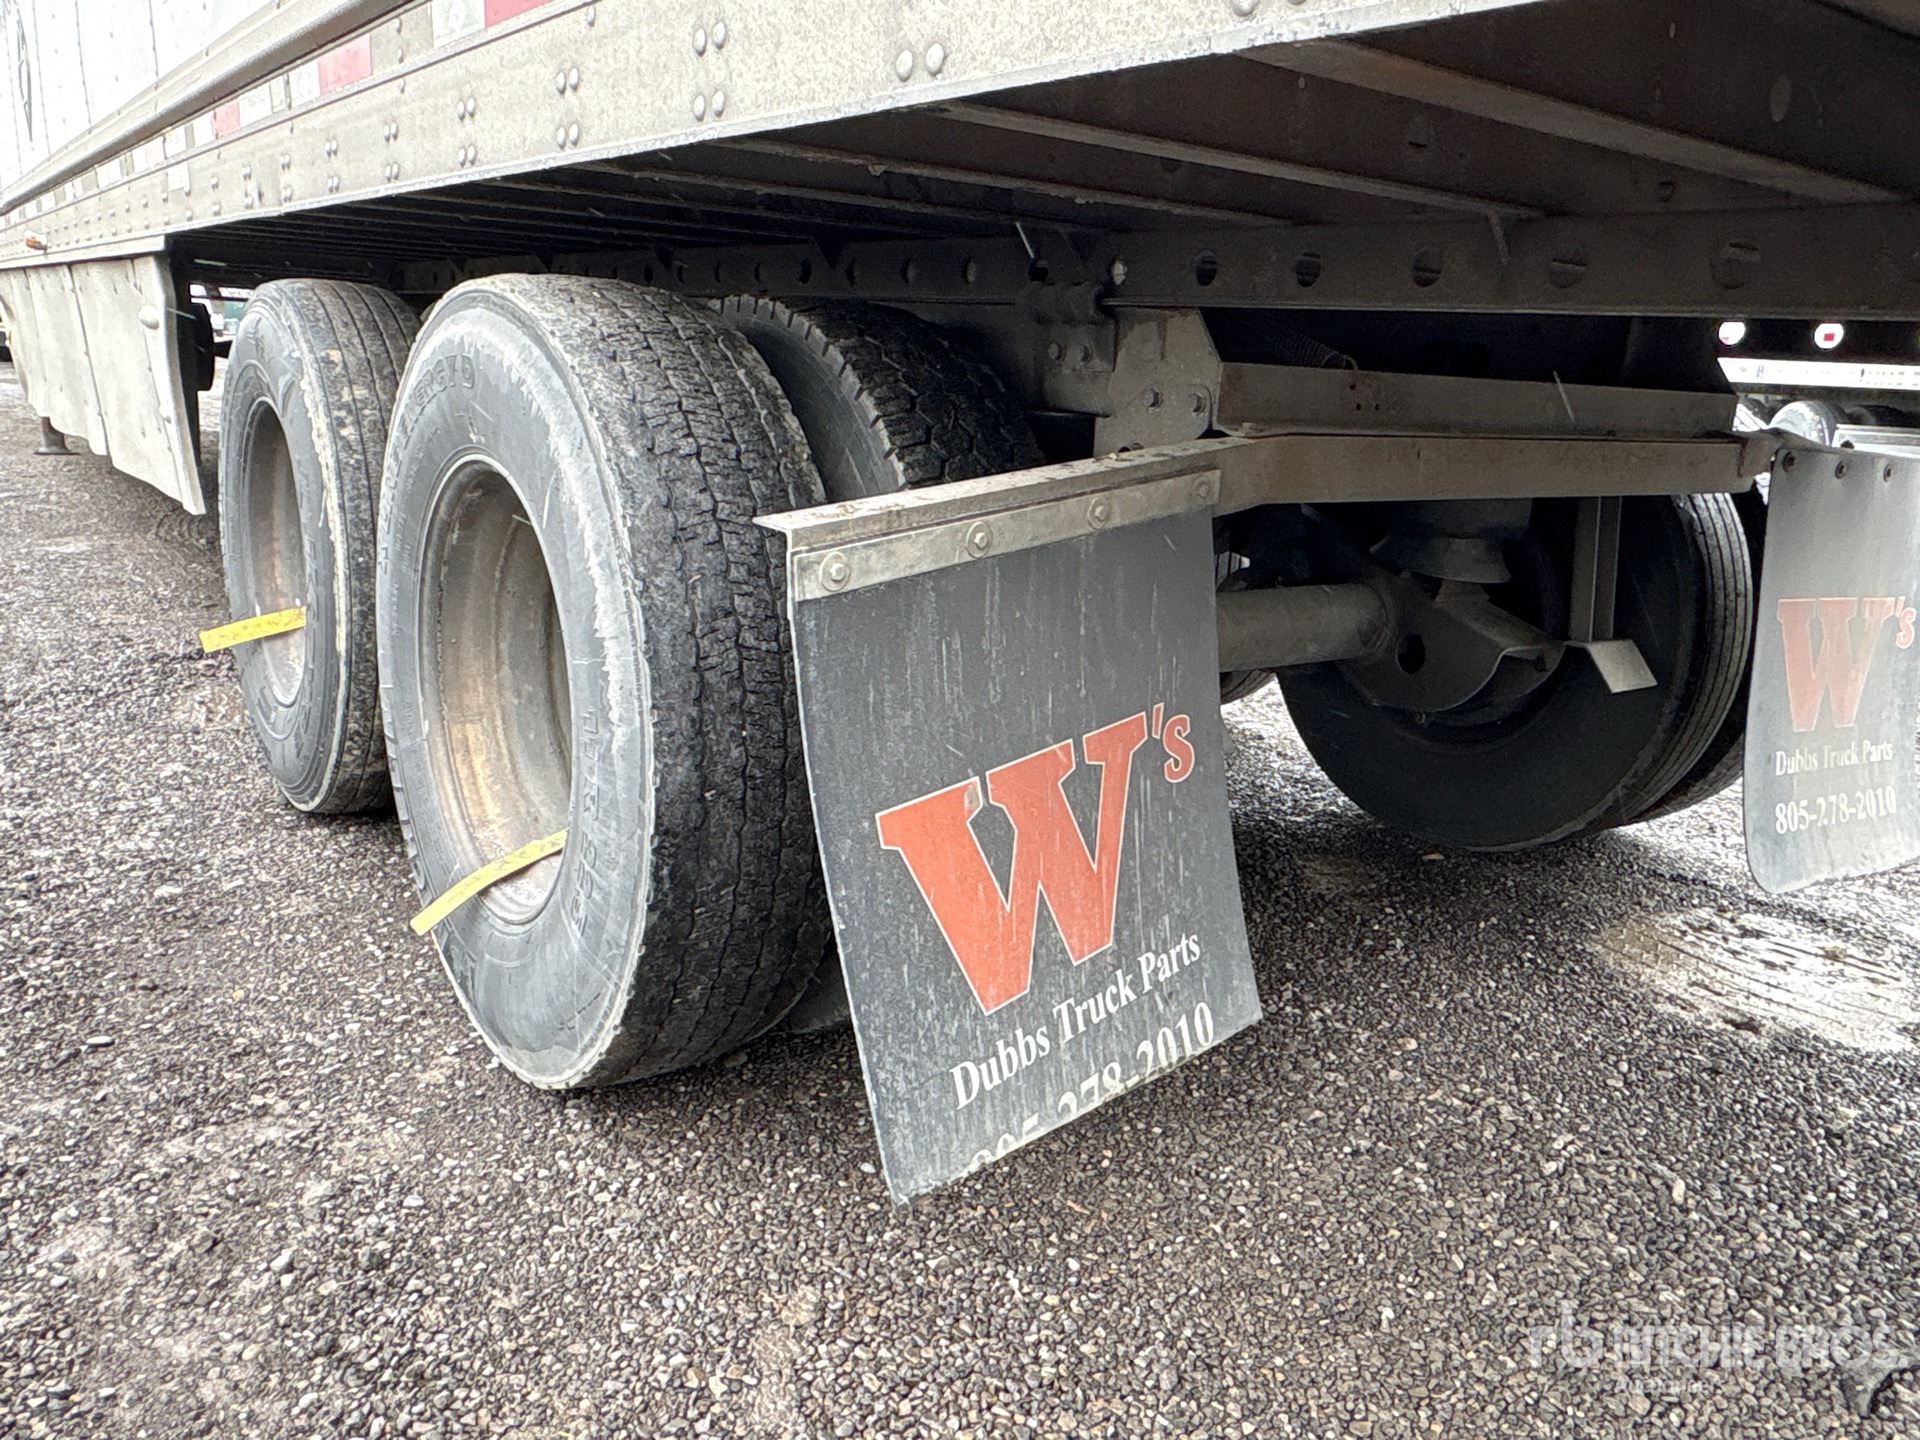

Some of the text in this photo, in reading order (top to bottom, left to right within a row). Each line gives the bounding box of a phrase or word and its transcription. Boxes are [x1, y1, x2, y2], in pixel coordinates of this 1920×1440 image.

[1777, 596, 1917, 732] W's
[1775, 739, 1893, 776] Dubbs Truck Parts
[1775, 785, 1896, 834] 805-278-2010
[876, 703, 1195, 1016] W's
[949, 932, 1200, 1110] Dubbs Truck Parts
[965, 1002, 1214, 1172] 278-2010
